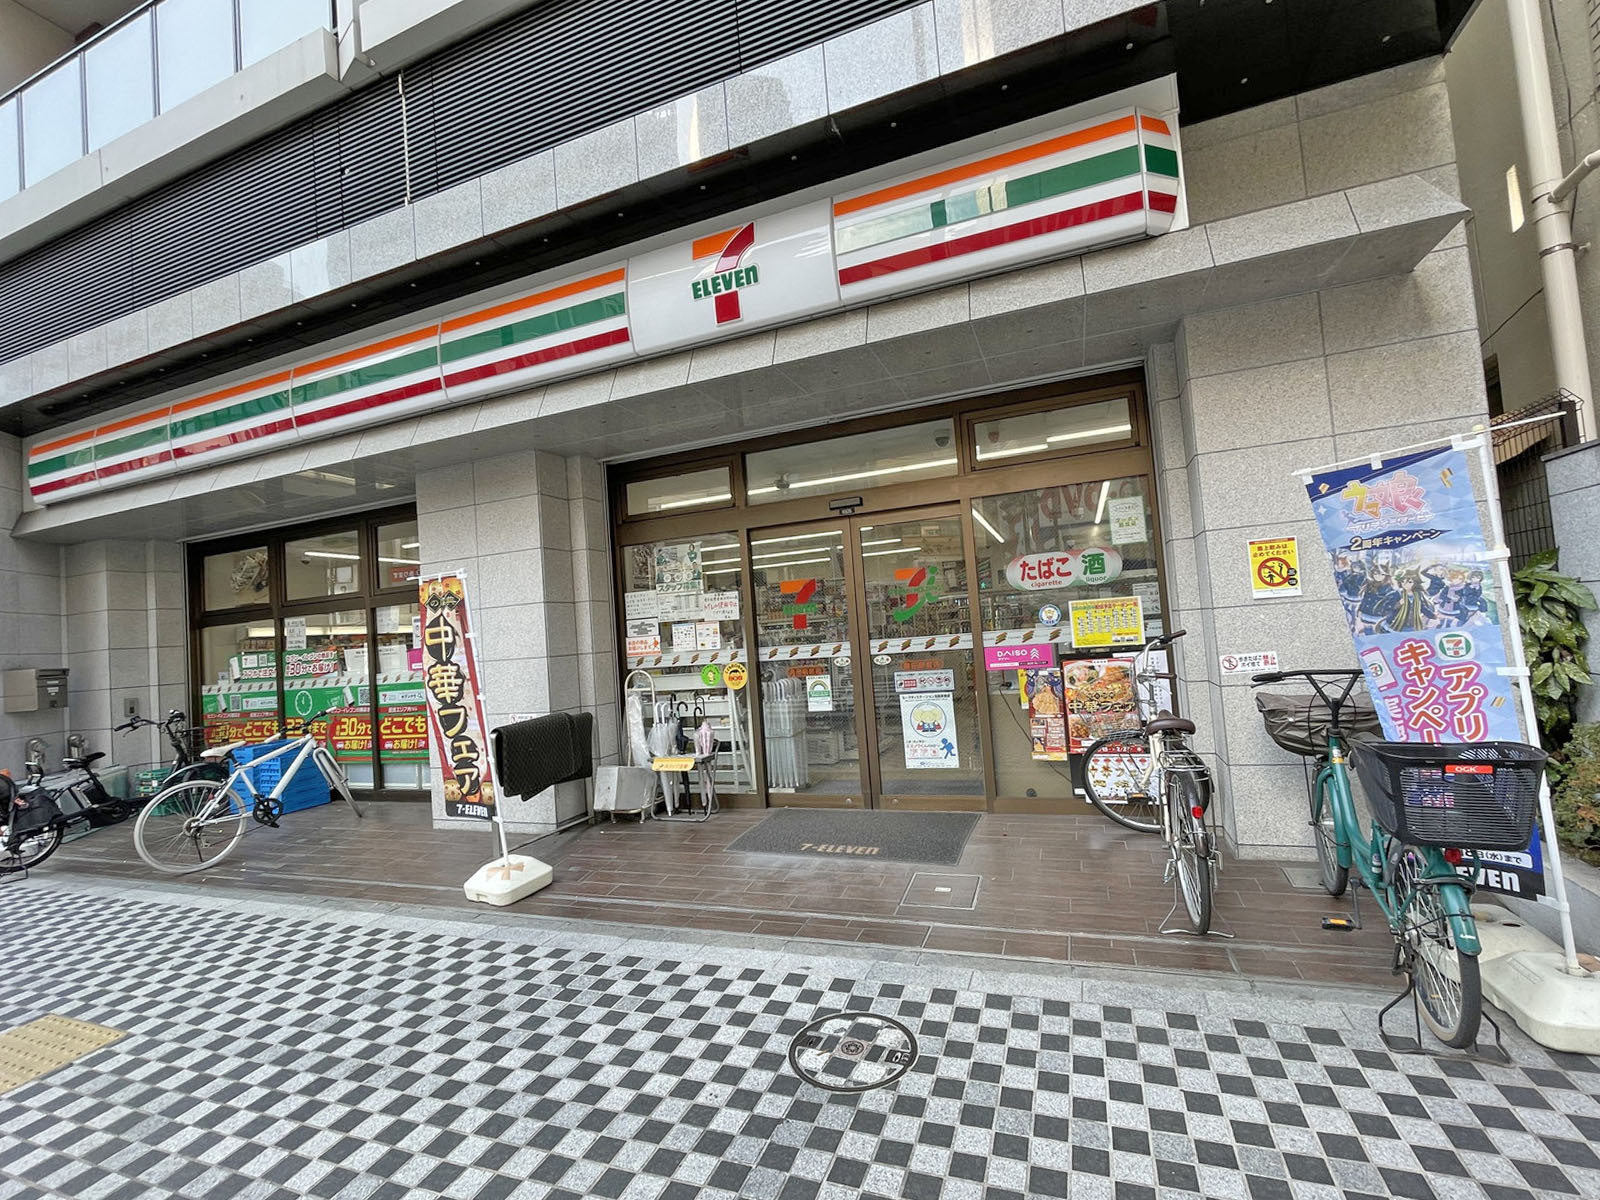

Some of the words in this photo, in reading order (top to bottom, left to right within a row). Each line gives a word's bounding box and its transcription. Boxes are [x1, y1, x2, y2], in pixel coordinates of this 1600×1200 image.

[1350, 530, 1441, 550] 2周年キャンペーン
[1020, 557, 1072, 581] たばこ
[1082, 553, 1105, 575] 酒
[1030, 580, 1063, 588] cigarette
[997, 649, 1028, 657] DAISO
[424, 614, 480, 796] 中華フェア
[1442, 664, 1484, 742] アプリ
[380, 716, 426, 734] どこでも
